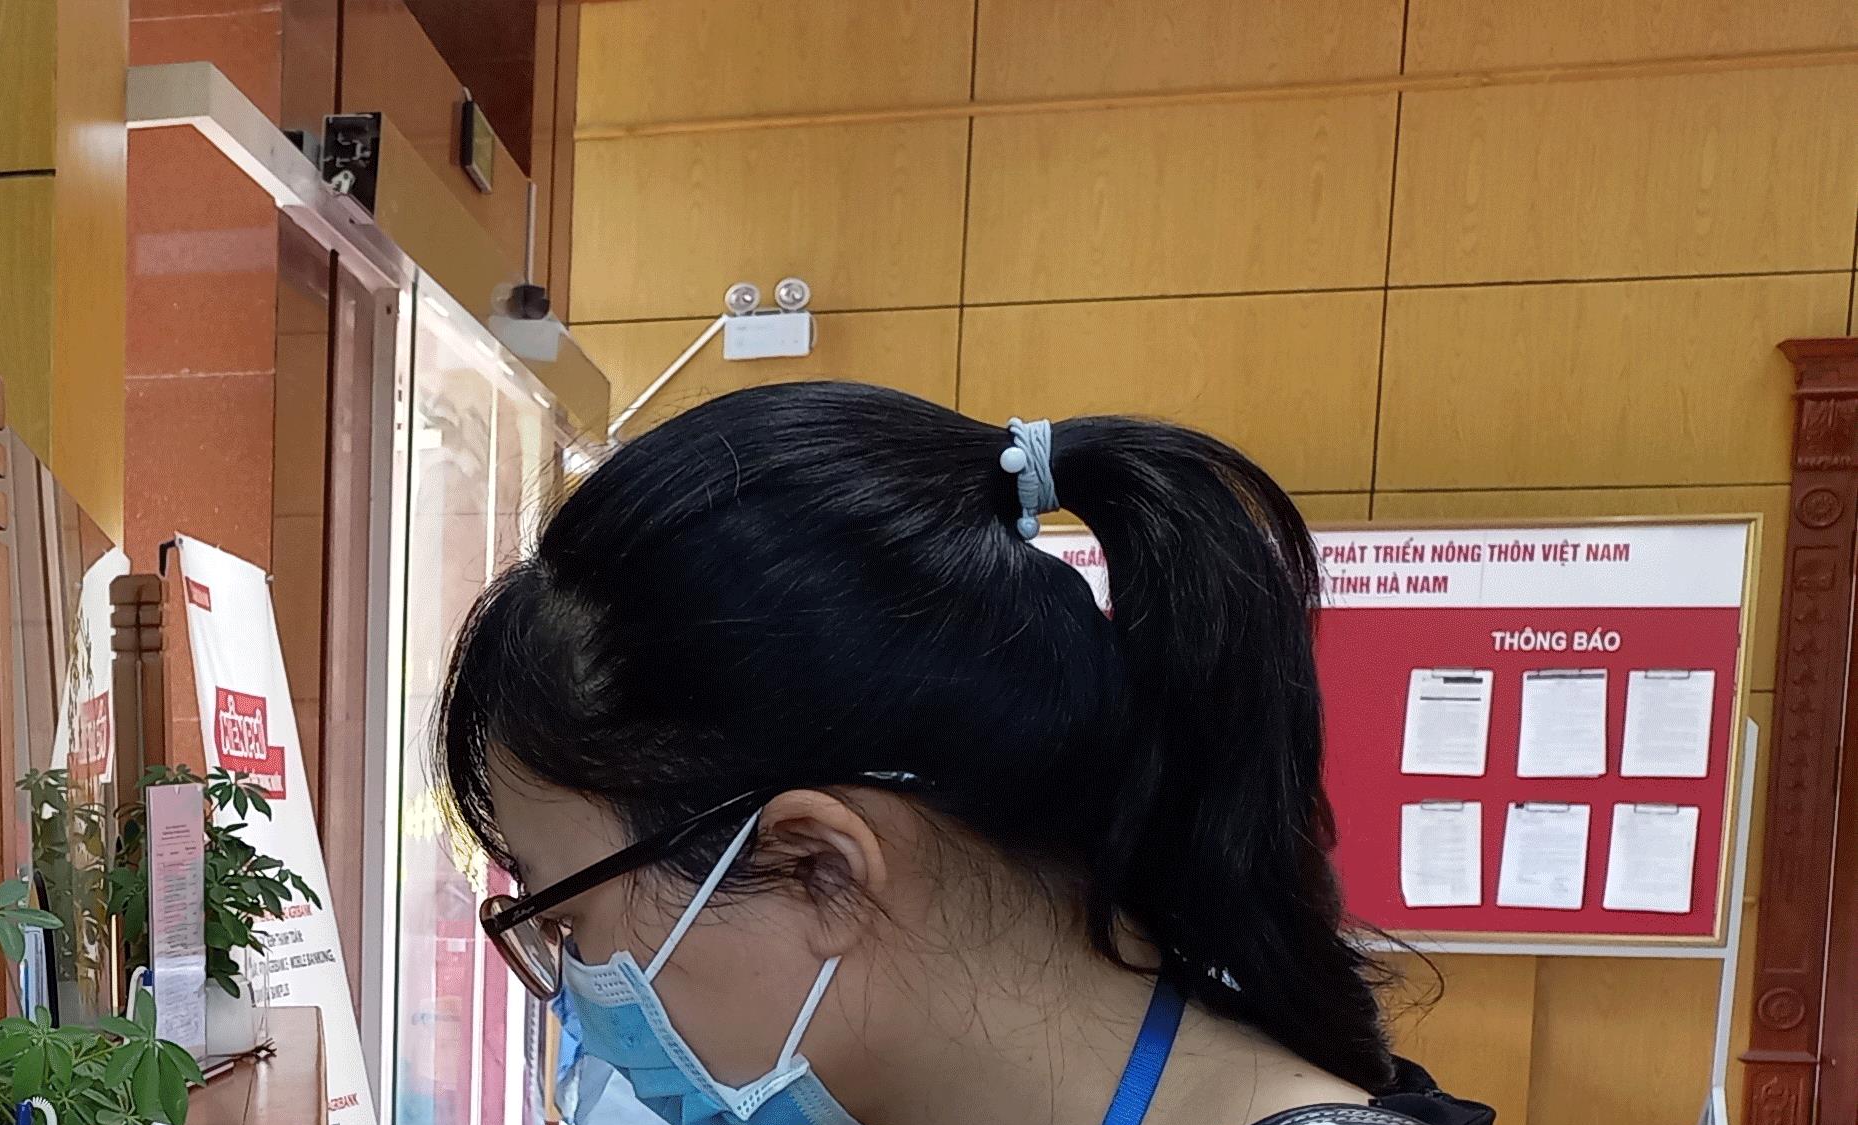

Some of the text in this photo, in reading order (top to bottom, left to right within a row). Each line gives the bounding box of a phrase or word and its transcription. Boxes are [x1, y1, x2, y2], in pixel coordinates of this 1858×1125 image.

[1322, 542, 1368, 564] PHÁT
[1373, 537, 1426, 564] TRIỂN
[1430, 540, 1482, 564] NÔNG
[1488, 539, 1536, 563] THÔN
[1541, 538, 1581, 566] VIỆT
[1585, 542, 1630, 563] NAM
[1331, 569, 1371, 594] TỈNH
[1376, 572, 1400, 594] HÀ
[1406, 575, 1449, 594] NAM
[1492, 626, 1621, 652] THÔNG BÁO
